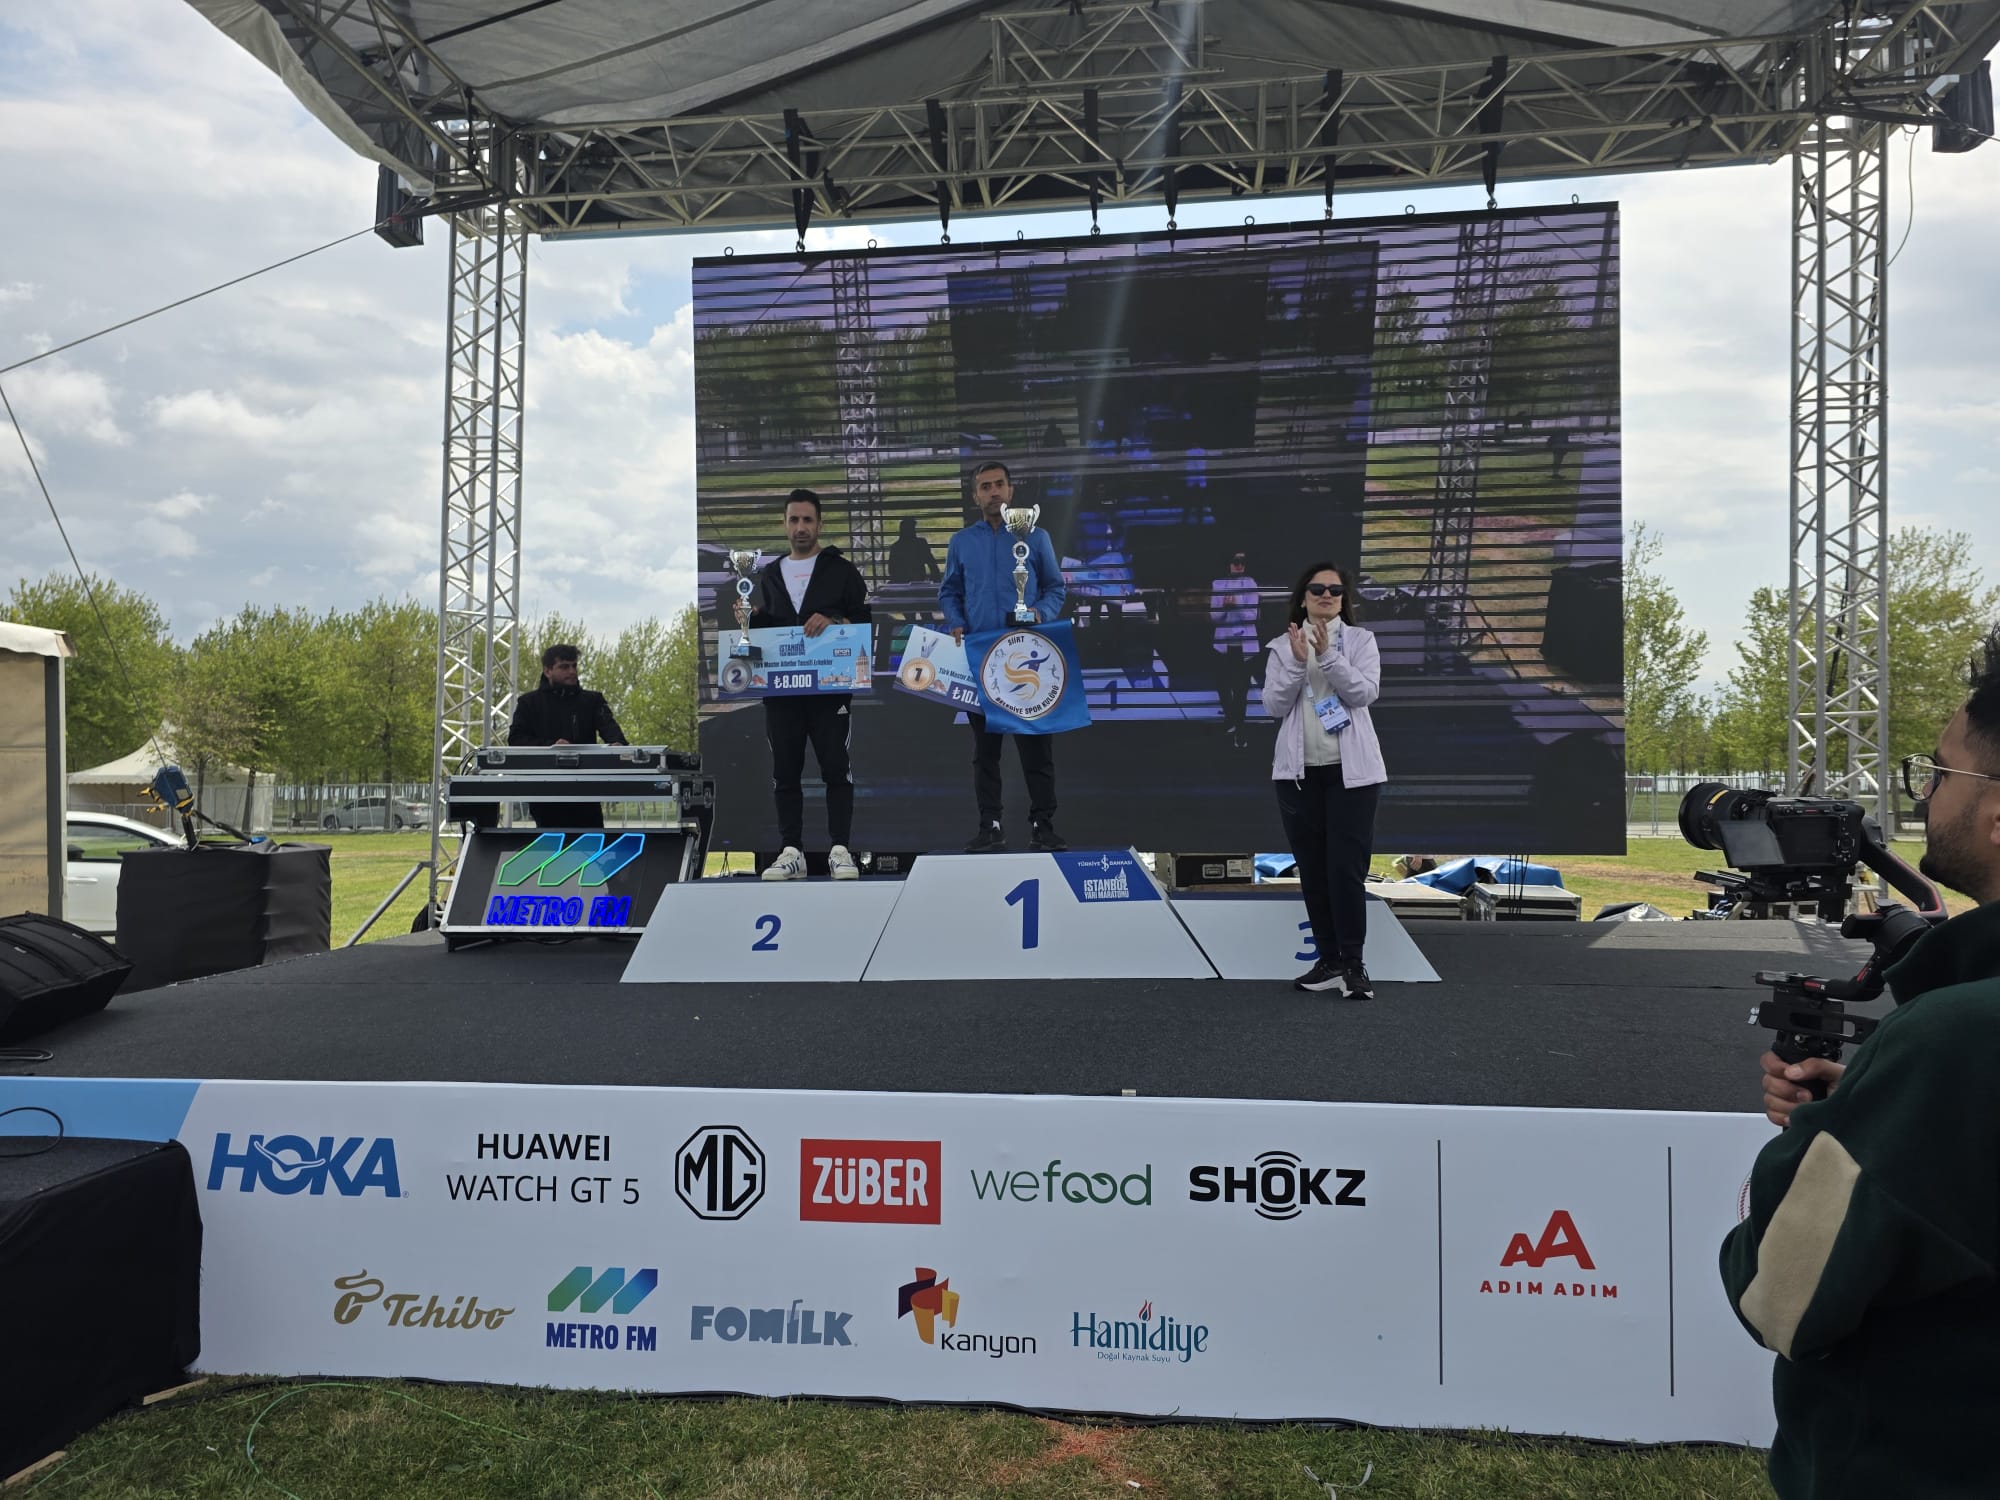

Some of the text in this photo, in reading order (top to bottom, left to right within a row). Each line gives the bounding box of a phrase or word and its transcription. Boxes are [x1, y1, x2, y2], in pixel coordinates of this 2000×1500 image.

[731, 669, 742, 684] 2
[915, 668, 923, 681] 1
[1025, 704, 1042, 715] SPOR
[486, 895, 632, 927] METRO FM
[1004, 878, 1040, 950] 1
[751, 914, 782, 951] 2
[477, 1133, 610, 1162] HUAWEI
[206, 1132, 401, 1198] HOKA
[682, 1134, 759, 1212] MG
[446, 1174, 640, 1205] WATCH GT 5
[811, 1156, 929, 1208] ZÜBER
[1188, 1164, 1367, 1207] SHOKZ
[1480, 1280, 1618, 1299] ADIM ADIM
[383, 1293, 516, 1331] Tchibo
[546, 1322, 657, 1352] METRO FM
[1070, 1311, 1209, 1363] Hamidiye
[1097, 1350, 1171, 1364] Doğal Kaynak Suyu
